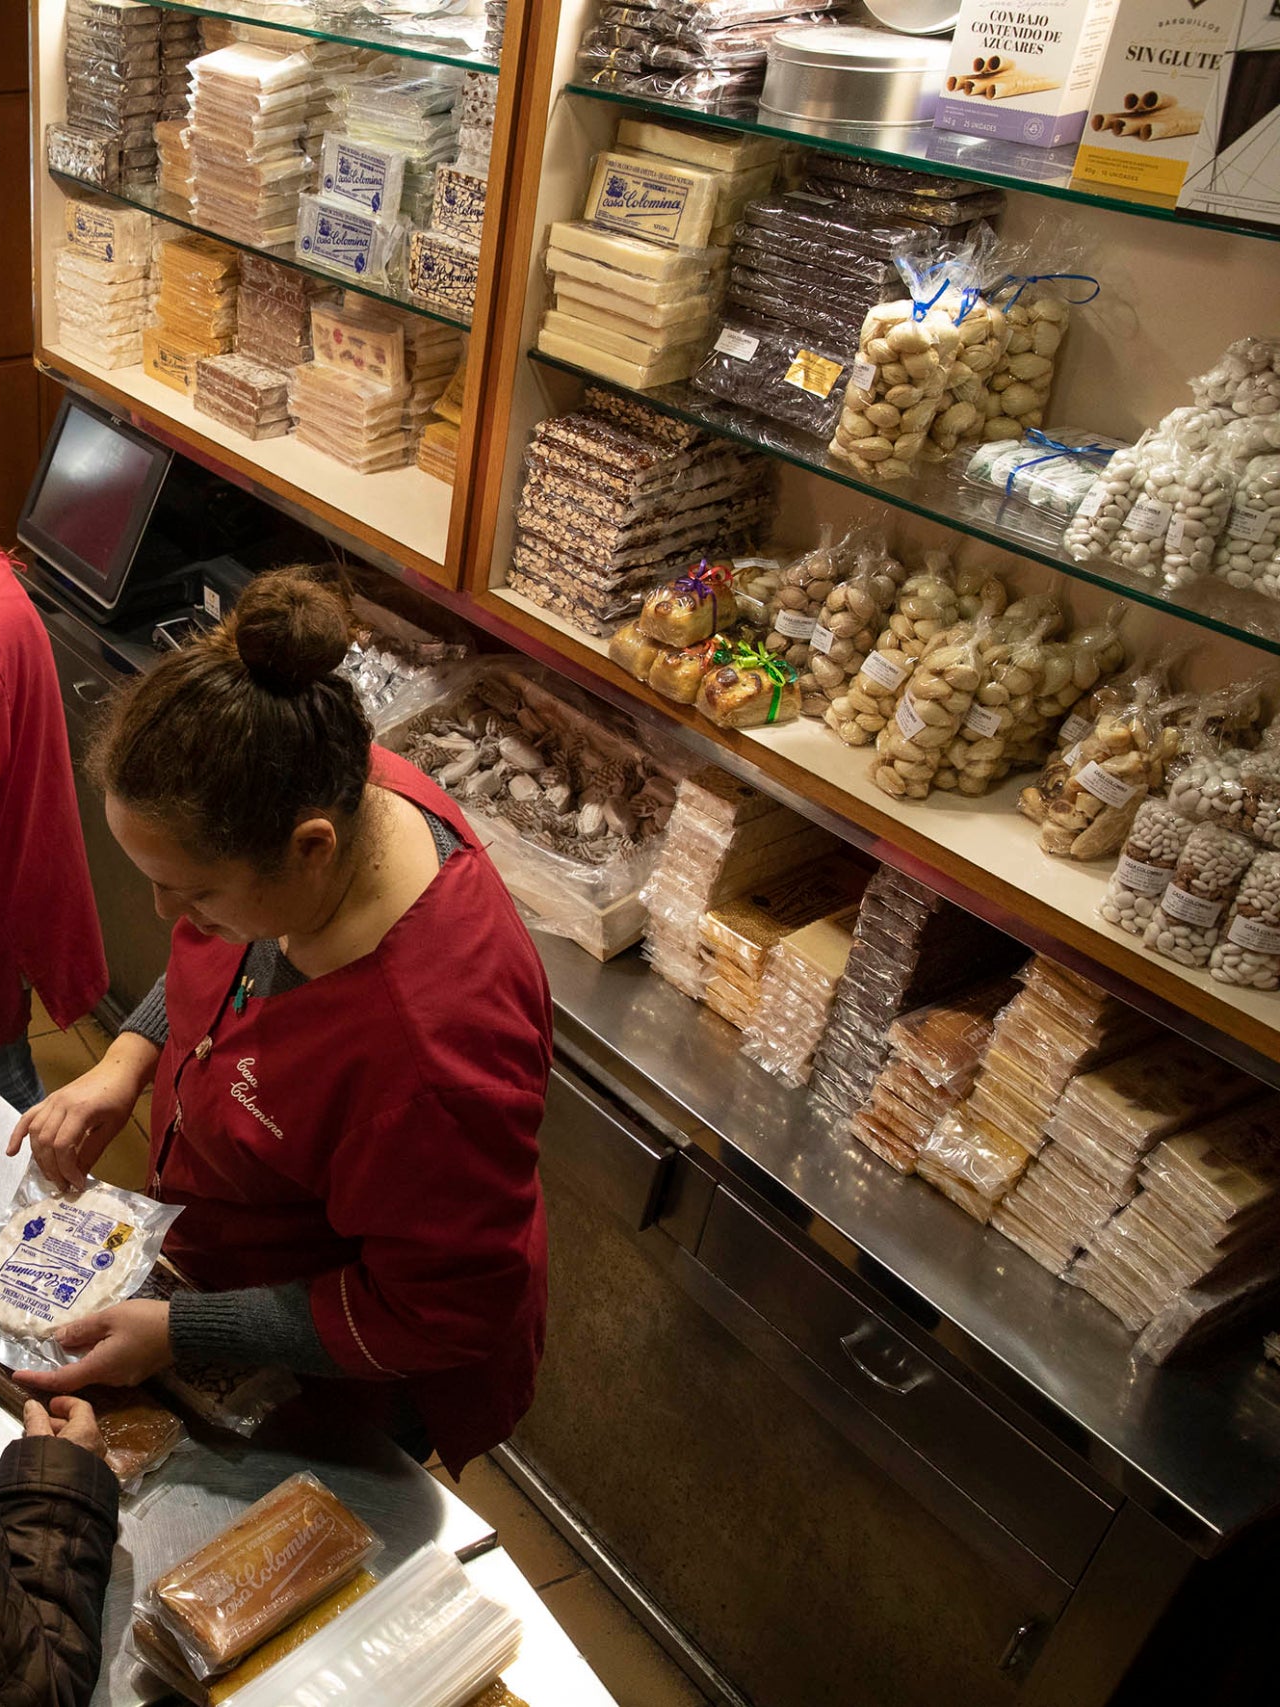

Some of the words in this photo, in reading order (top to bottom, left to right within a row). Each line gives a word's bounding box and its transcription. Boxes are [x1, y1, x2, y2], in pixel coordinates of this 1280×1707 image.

[990, 9, 1015, 23] CON
[1016, 12, 1049, 27] BAJO
[971, 21, 1043, 41] CONTENIDO
[1044, 31, 1062, 43] DE
[982, 35, 1045, 55] AZÚCARES
[1125, 45, 1155, 63] SIN
[350, 170, 383, 185] Colomina
[603, 198, 623, 207] casa
[623, 190, 681, 209] Colomina
[330, 231, 368, 246] Colomina
[236, 1058, 258, 1088] Casa
[230, 1082, 284, 1139] Colomina
[5, 1264, 63, 1287] Colomina
[62, 1273, 85, 1286] casa
[235, 1511, 328, 1588] Colomina
